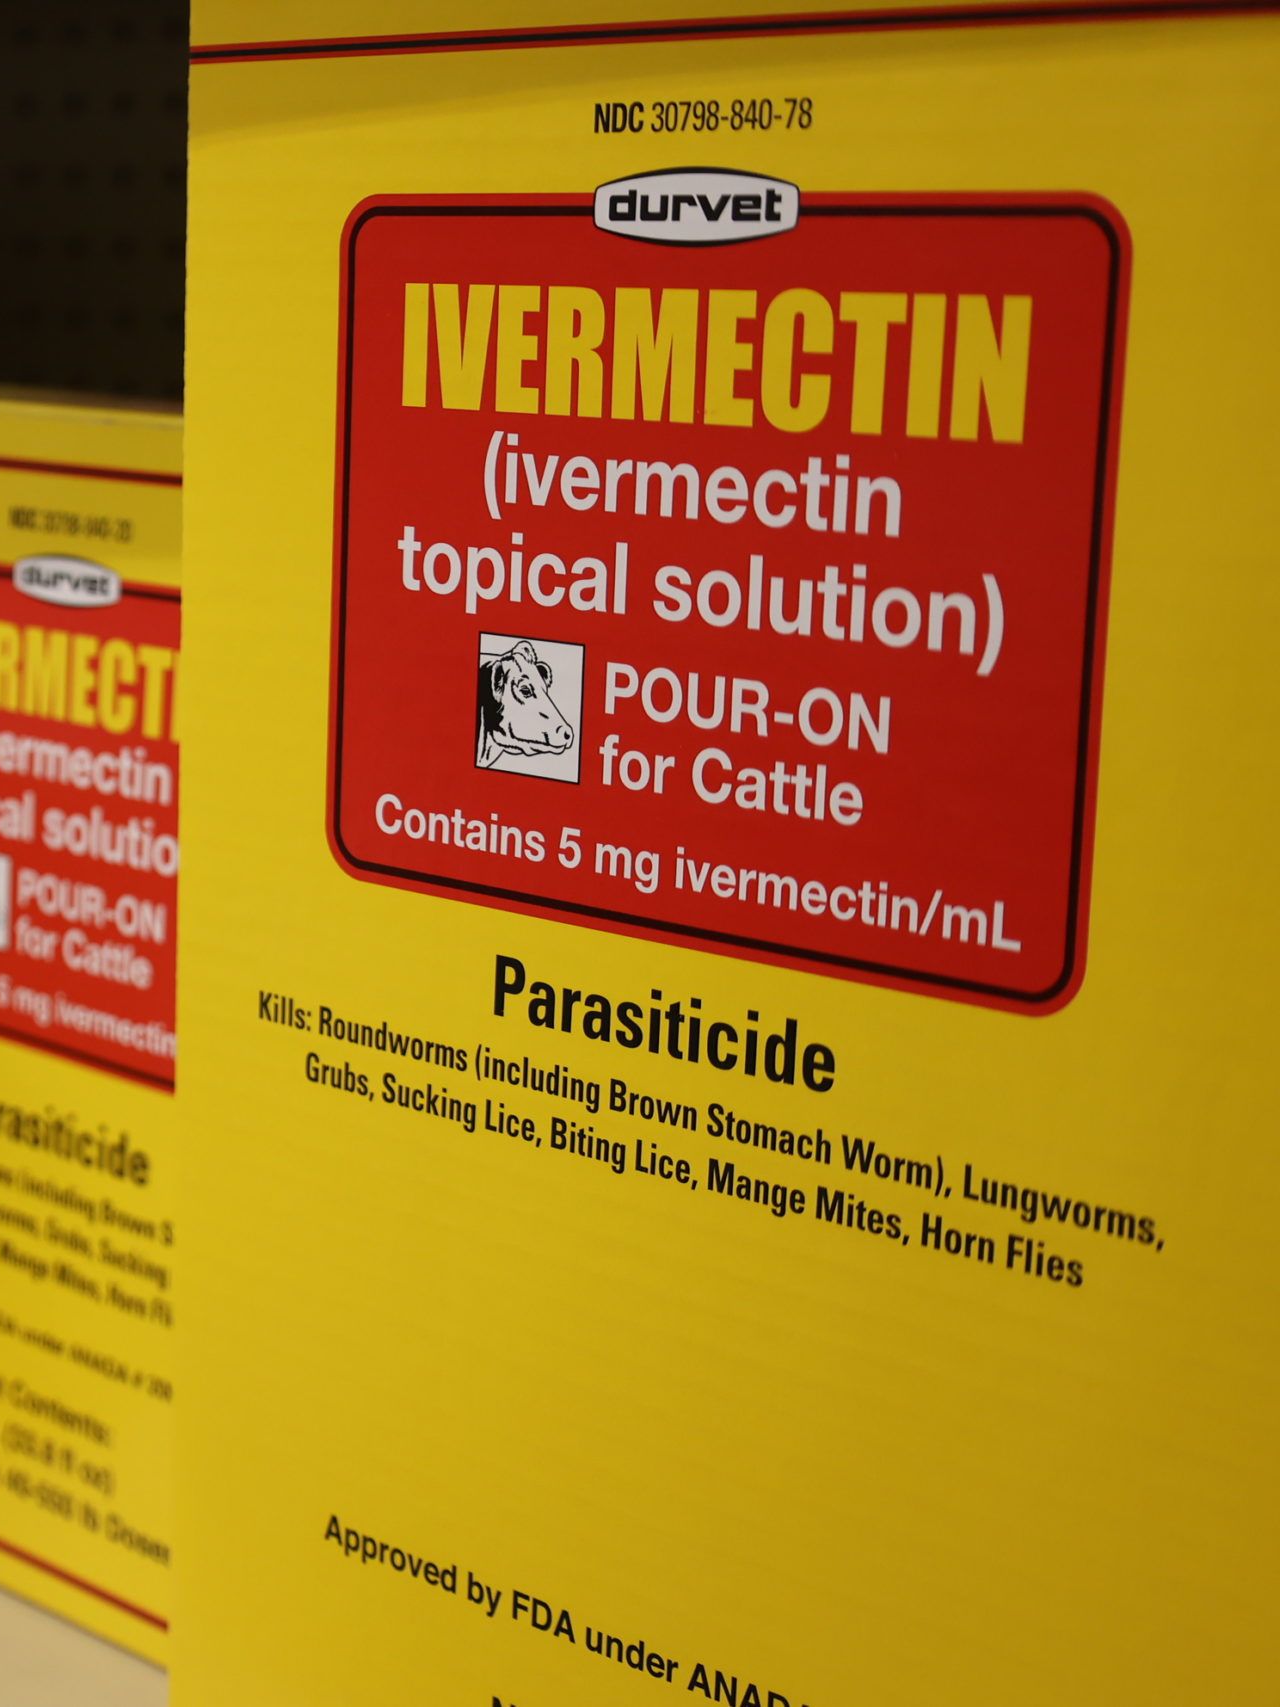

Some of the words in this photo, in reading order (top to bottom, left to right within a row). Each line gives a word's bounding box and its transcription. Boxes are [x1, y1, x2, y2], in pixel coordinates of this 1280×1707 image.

[593, 102, 645, 133] NDC
[650, 97, 814, 133] 30798-840-78
[608, 188, 783, 223] durvet
[402, 282, 1032, 445] IVERMECTIN
[483, 430, 902, 538] (ivermectin
[397, 525, 629, 615] topical
[652, 554, 1004, 677] solution)
[603, 661, 892, 754] POUR-ON
[598, 735, 675, 795] for
[691, 747, 864, 826] Cattle
[16, 867, 167, 944] POUR-ON
[374, 793, 546, 863] Contains
[558, 828, 582, 869] 5
[594, 842, 661, 894] mg
[674, 845, 1022, 953] ivermectin/mL
[15, 915, 59, 962] for
[62, 928, 153, 990] Cattle
[493, 953, 836, 1093] Parasiticide
[258, 990, 312, 1033] Kills:
[319, 1005, 468, 1072] Roundworms
[475, 1043, 601, 1114] (including
[609, 1078, 698, 1132] Brown
[707, 1102, 832, 1165] Stomach
[841, 1134, 953, 1199] Worm),
[963, 1163, 1166, 1253] Lungworms,
[305, 1052, 376, 1102] Grubs,
[382, 1072, 477, 1133] Sucking
[484, 1099, 542, 1149] Lice,
[550, 1117, 627, 1175] Biting
[635, 1139, 698, 1191] Lice,
[707, 1157, 806, 1218] Mange
[815, 1186, 911, 1247] Mites,
[920, 1212, 995, 1265] Horn
[1006, 1233, 1085, 1288] Flies
[324, 1514, 458, 1595] Approved
[467, 1571, 502, 1618] by
[511, 1590, 576, 1645] FDA
[585, 1626, 679, 1684] under
[687, 1663, 811, 1707] ANAD
